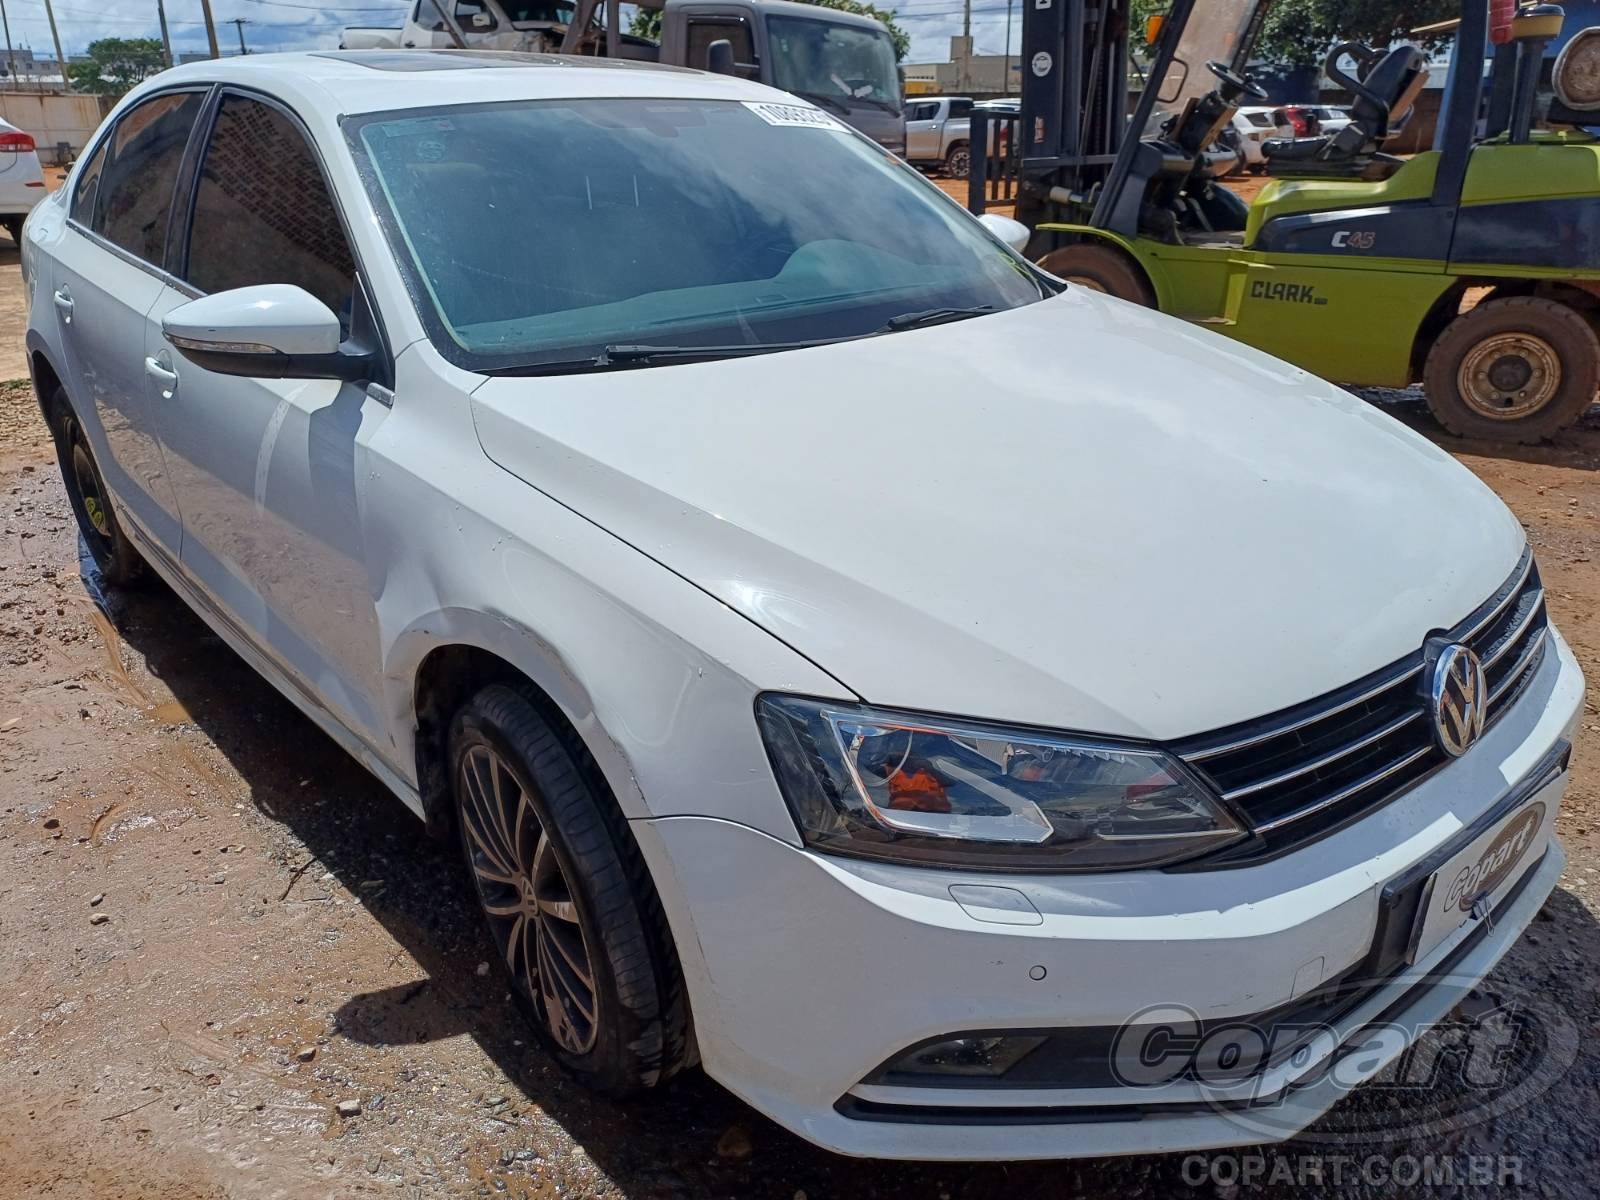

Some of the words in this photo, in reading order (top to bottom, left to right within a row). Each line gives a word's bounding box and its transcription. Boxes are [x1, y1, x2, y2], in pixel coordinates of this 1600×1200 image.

[1331, 231, 1375, 248] C45
[1251, 281, 1315, 304] CLARK
[1444, 814, 1536, 912] Copart
